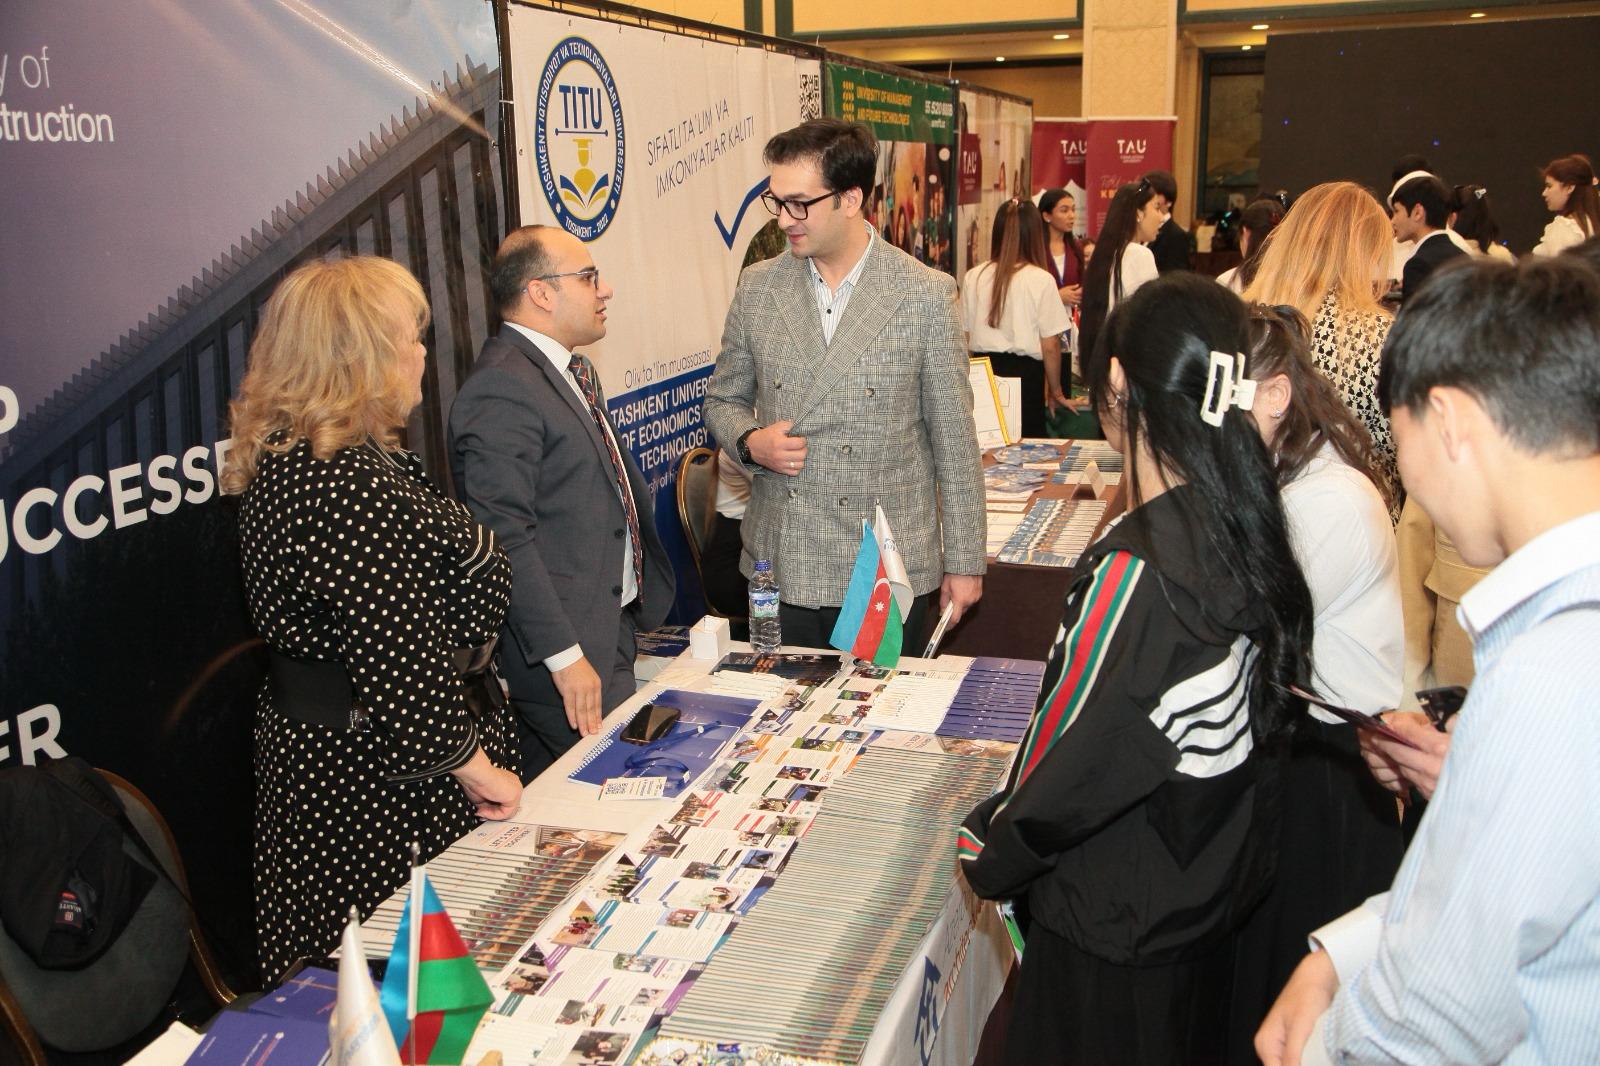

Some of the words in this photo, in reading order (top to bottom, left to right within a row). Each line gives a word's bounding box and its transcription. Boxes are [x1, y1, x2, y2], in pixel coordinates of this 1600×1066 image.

[21, 46, 50, 89] of
[0, 103, 114, 142] truction
[559, 84, 602, 130] TITU
[647, 124, 681, 166] SIFATLI
[715, 98, 730, 122] VA
[1060, 139, 1088, 154] TAU
[1117, 139, 1147, 154] TAU
[538, 126, 556, 200] TOSHKENT
[614, 108, 625, 195] UNIVERSITETI
[656, 132, 727, 199] IMKONIYATLAR
[728, 116, 755, 148] KALITI
[963, 151, 977, 174] TAU
[611, 390, 670, 428] TASHKENT
[639, 404, 701, 447] ECONOMICS
[640, 426, 708, 472] TECHNOLOGY
